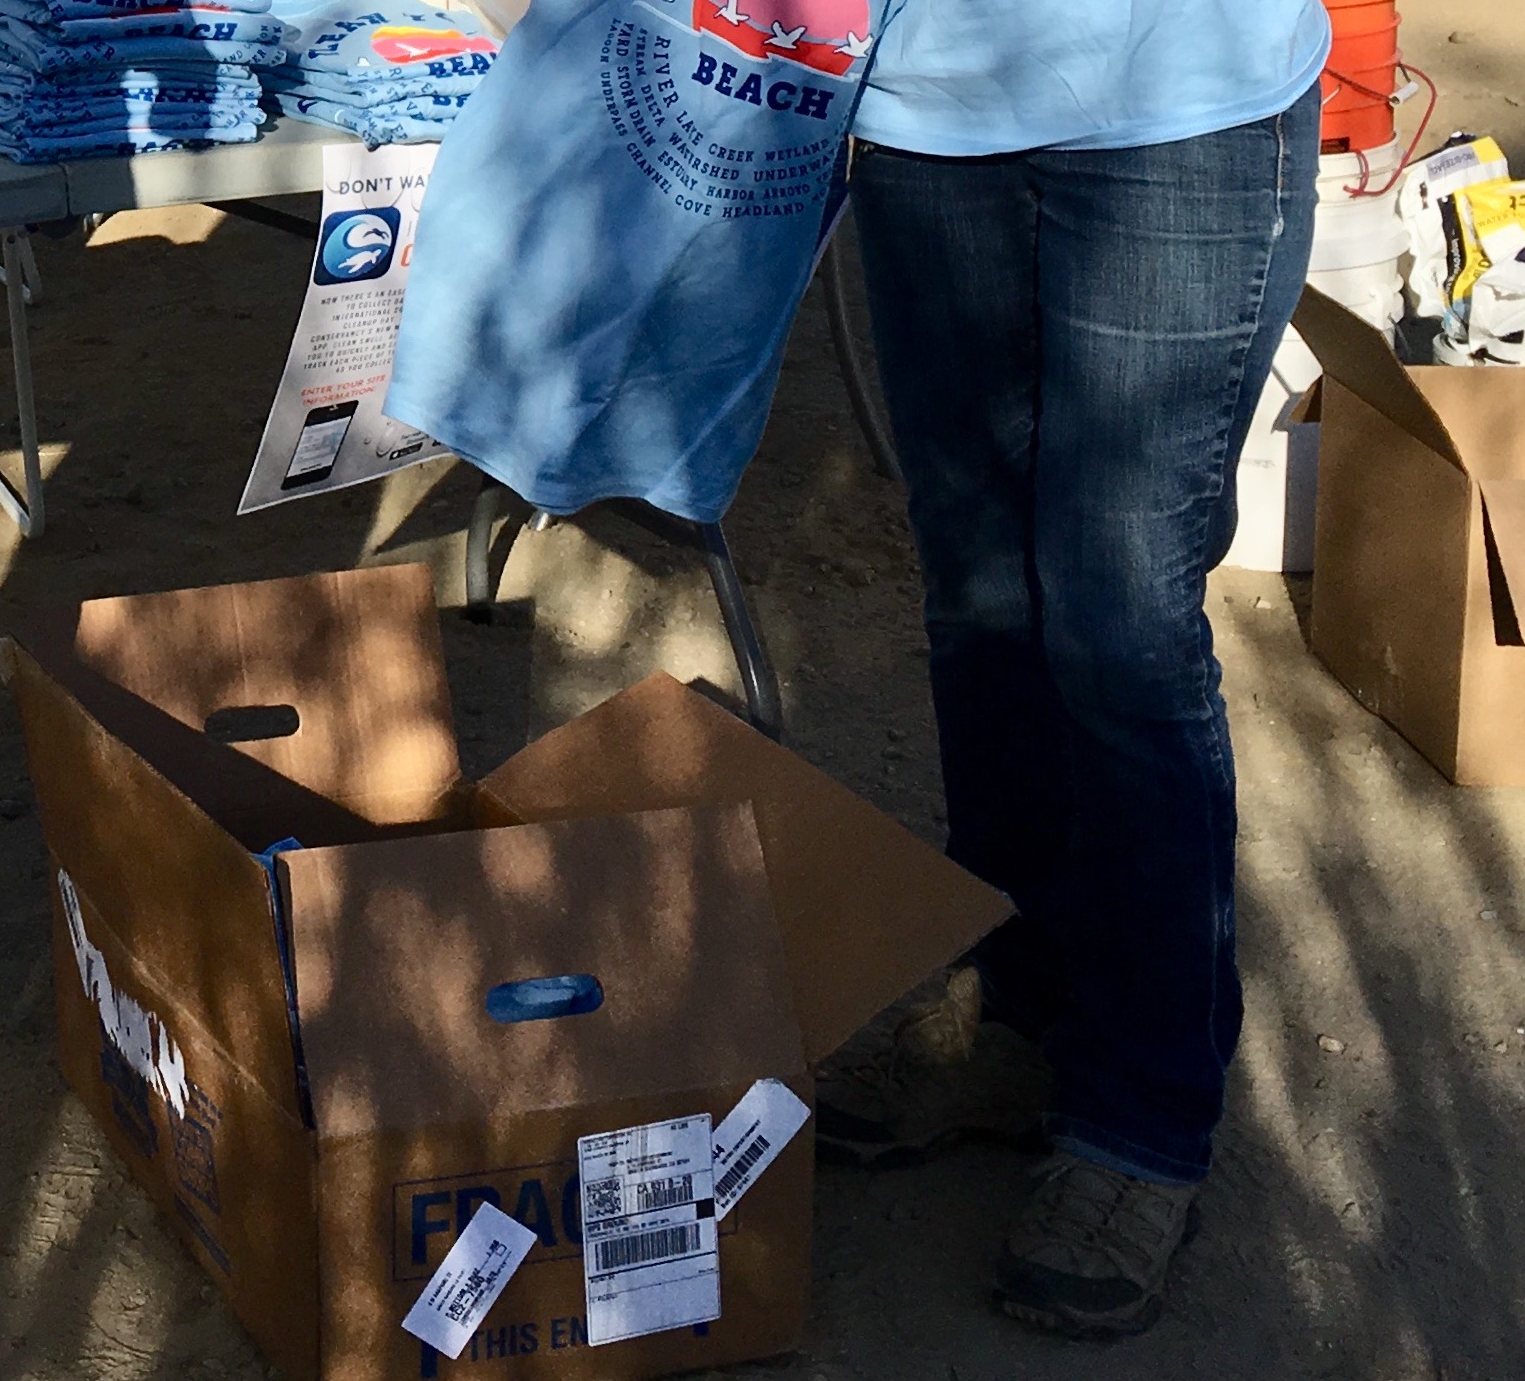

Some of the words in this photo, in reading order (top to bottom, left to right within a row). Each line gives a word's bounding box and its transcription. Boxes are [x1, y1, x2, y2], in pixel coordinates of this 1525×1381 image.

[635, 28, 648, 76] STREAM
[641, 84, 666, 128] DELTA
[653, 35, 679, 108] RIVER
[676, 111, 703, 146] LAKE
[708, 143, 755, 163] CREEK
[765, 139, 829, 162] WETLAND
[691, 52, 835, 120] BEACH
[617, 22, 634, 57] YARD
[706, 186, 755, 201] HARBOR
[601, 71, 629, 137] UNDERPASS
[626, 141, 672, 195] CHANNEL
[675, 194, 713, 216] COVE
[722, 202, 805, 218] HEADLAND
[339, 178, 393, 194] DON'T
[301, 386, 332, 396] ENTER
[337, 379, 364, 390] YOUR
[366, 374, 385, 384] SITE
[303, 387, 376, 406] INFORMATION
[471, 1322, 538, 1359] THIS
